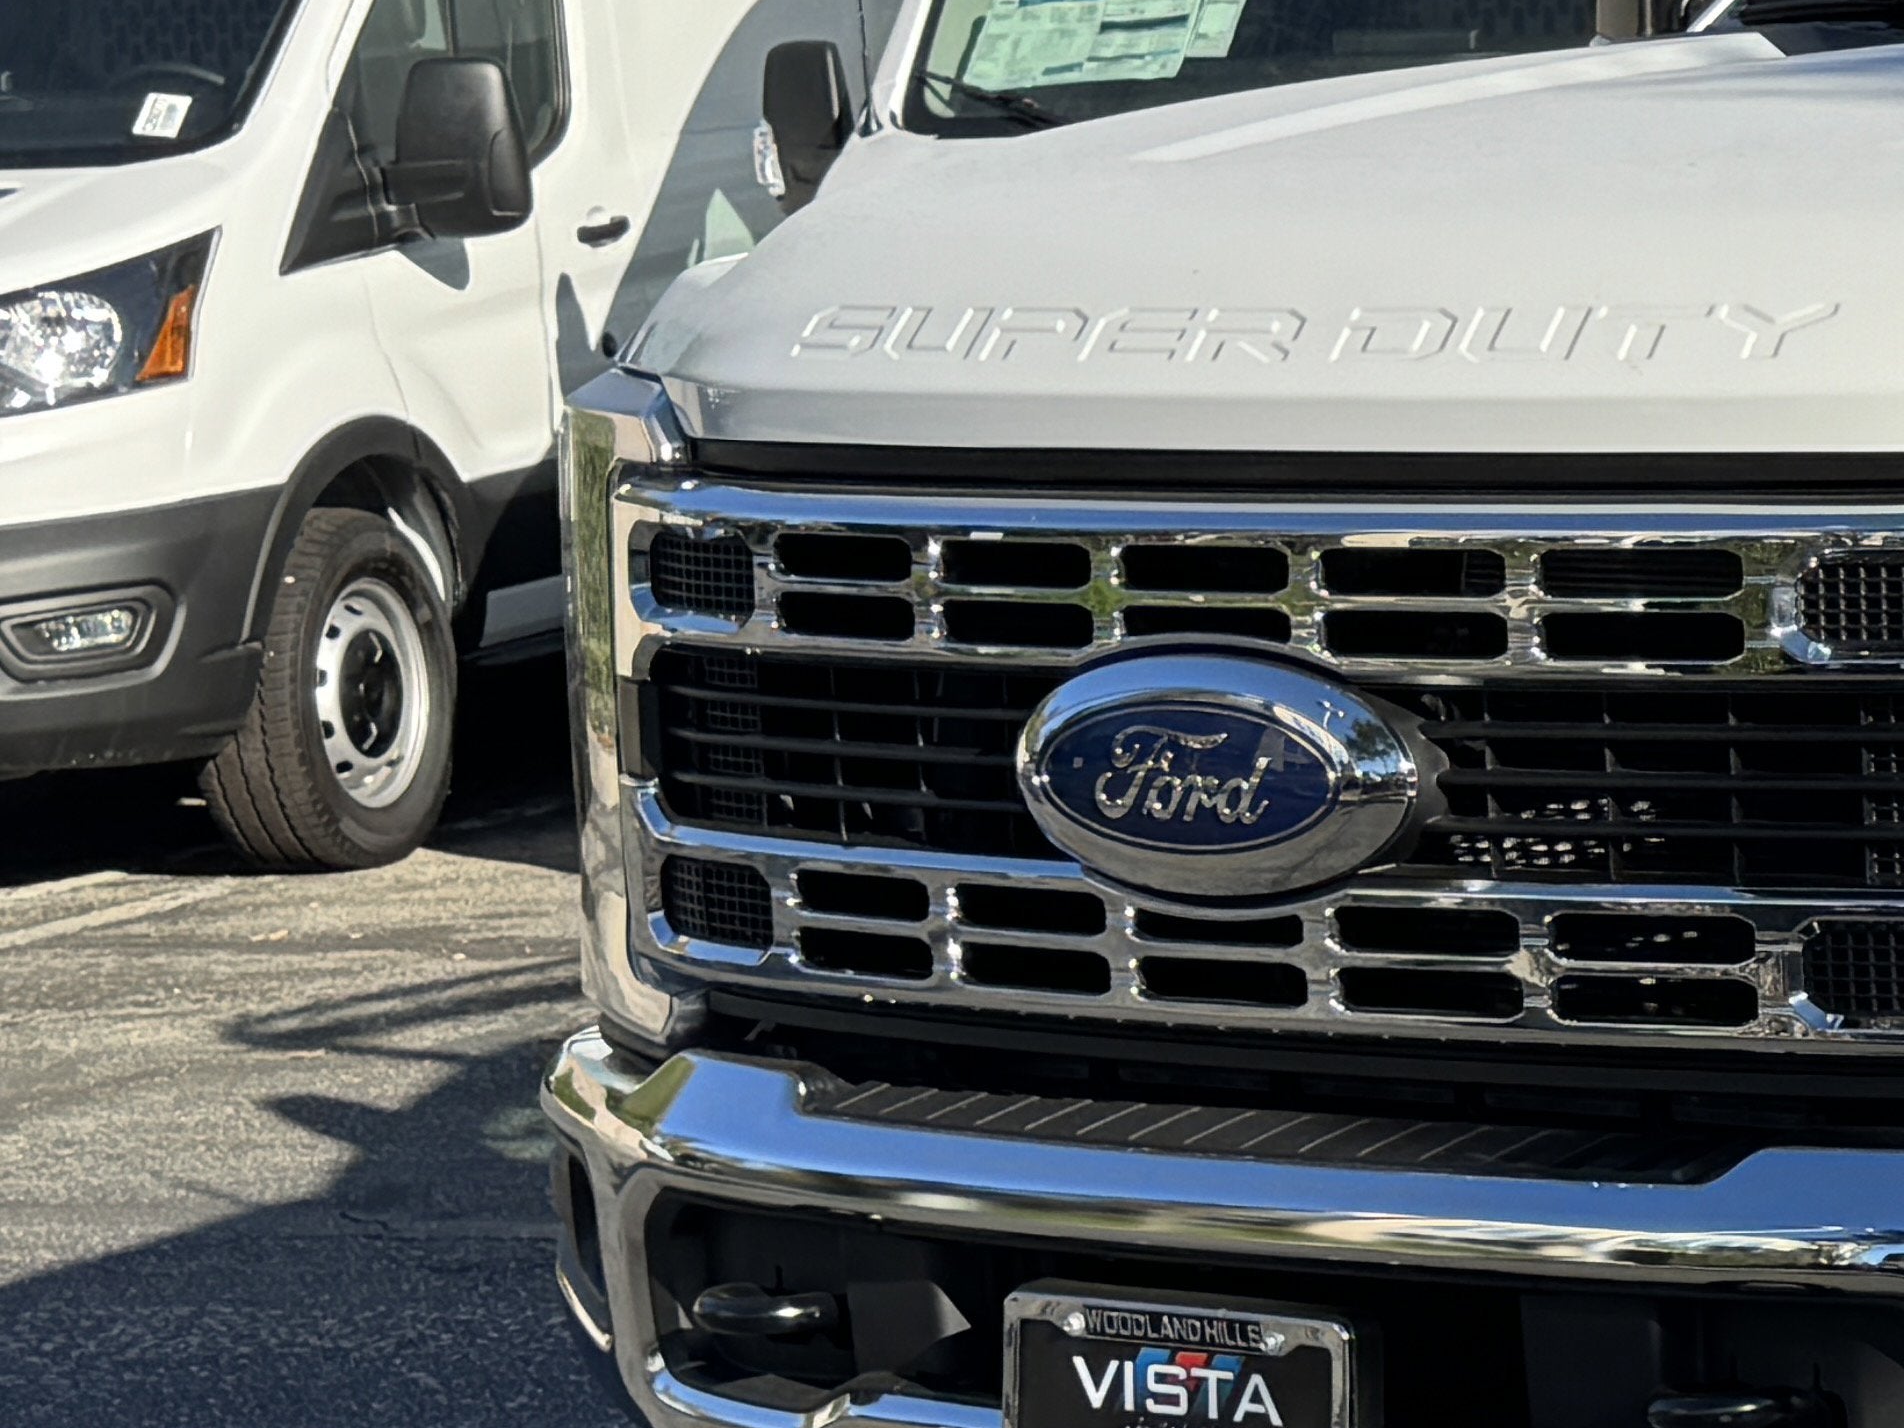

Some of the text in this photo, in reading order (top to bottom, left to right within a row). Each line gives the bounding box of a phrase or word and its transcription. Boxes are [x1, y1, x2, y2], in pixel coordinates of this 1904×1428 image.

[792, 301, 1842, 363] SUPER DUTY
[1094, 724, 1270, 826] Ford
[1085, 1308, 1201, 1342] WOODLAND
[1072, 1355, 1284, 1428] VISTA
